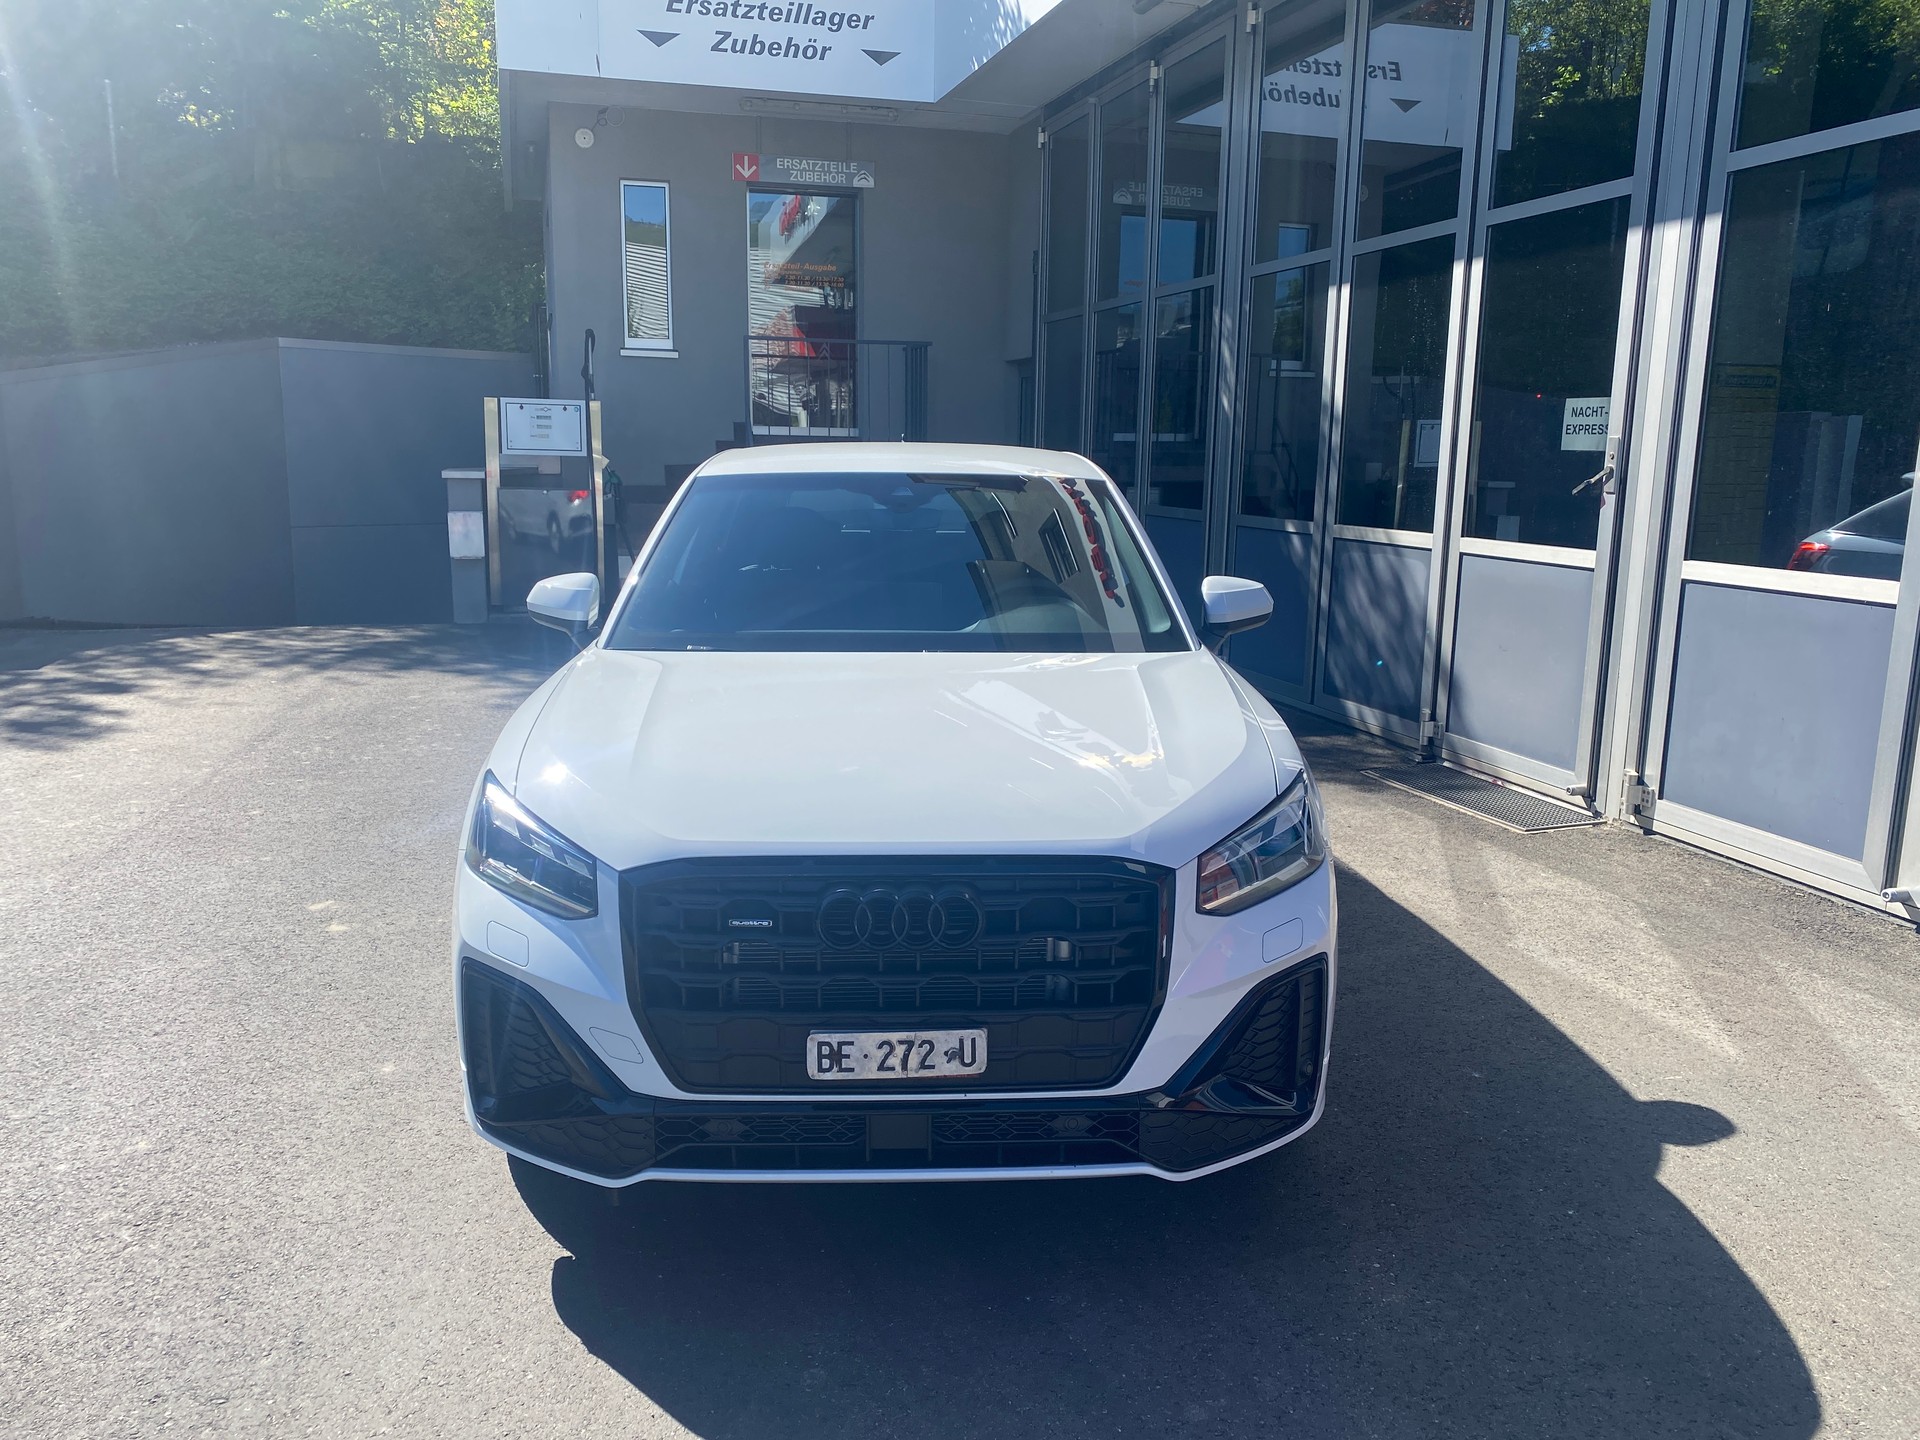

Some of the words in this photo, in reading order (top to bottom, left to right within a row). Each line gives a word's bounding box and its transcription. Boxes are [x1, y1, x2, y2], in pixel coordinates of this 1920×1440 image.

[666, 0, 875, 32] Ersatzteillager
[710, 30, 832, 60] Zubehör
[776, 158, 858, 173] ERSATZTEILE
[789, 170, 846, 183] ZUBEHÖR
[1571, 406, 1609, 418] NACHT-
[816, 1040, 855, 1075] BE
[876, 1038, 937, 1073] 272
[958, 1036, 977, 1068] U
